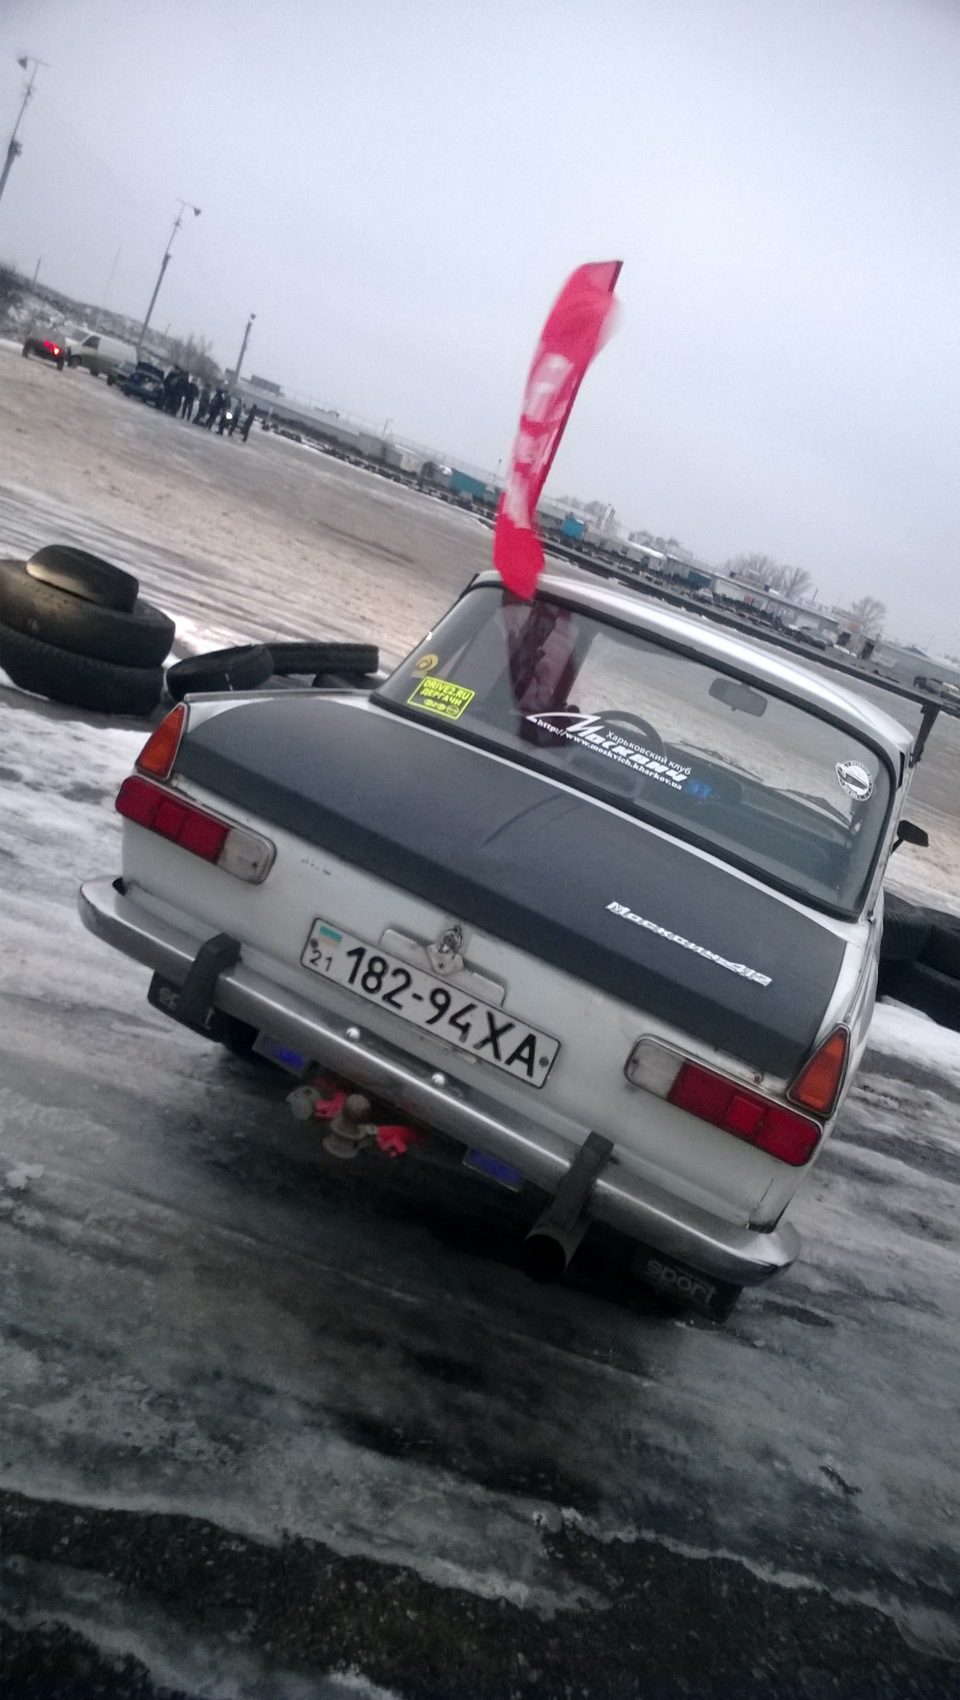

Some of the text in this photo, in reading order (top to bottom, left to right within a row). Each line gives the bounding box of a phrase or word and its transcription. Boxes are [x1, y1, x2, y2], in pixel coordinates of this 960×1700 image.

[423, 679, 470, 700] DRIVE2.RU
[606, 730, 692, 775] Харьковский клуб
[310, 949, 333, 972] 21
